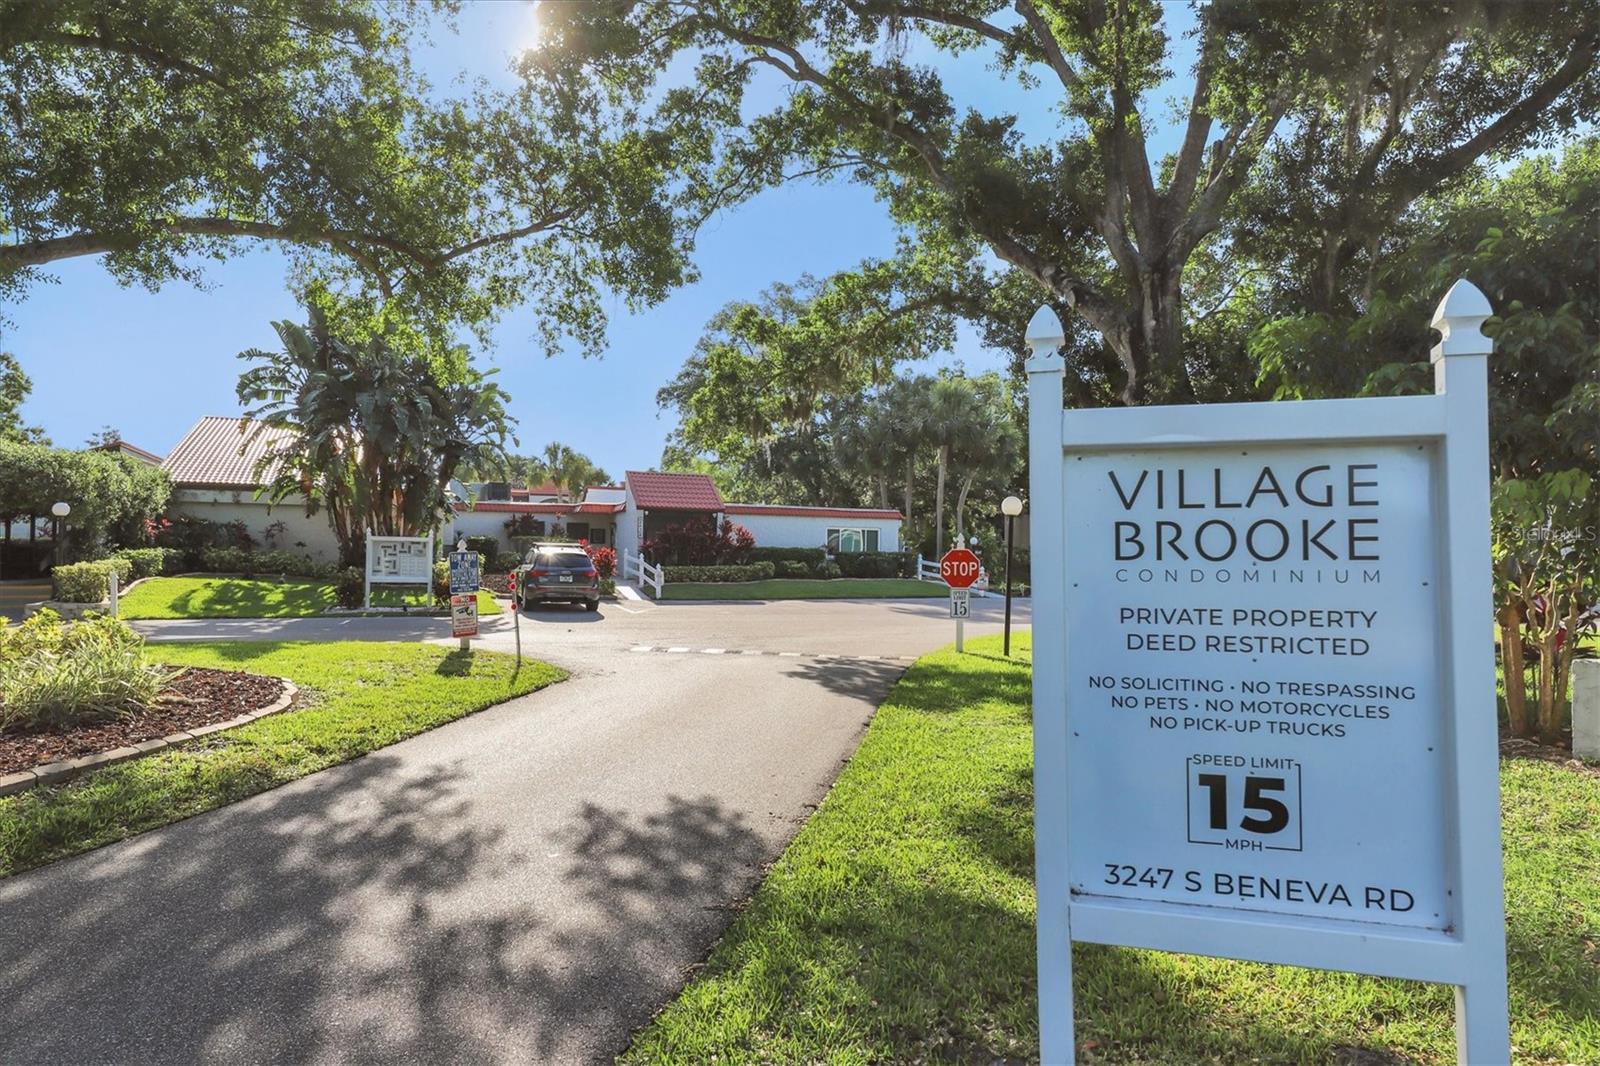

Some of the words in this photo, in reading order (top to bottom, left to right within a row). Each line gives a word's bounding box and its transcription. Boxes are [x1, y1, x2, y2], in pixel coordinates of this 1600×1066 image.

[1107, 464, 1379, 510] VILLAGE
[1114, 518, 1380, 562] BROOKE
[943, 561, 977, 576] STOP
[1115, 568, 1381, 584] CONDOMINIUM
[953, 601, 967, 616] 15
[1120, 607, 1223, 626] PRIVATE
[1233, 609, 1378, 629] PROPERTY
[1127, 633, 1196, 651] DEED
[1205, 635, 1369, 656] RESTRICTED
[1088, 675, 1116, 690] NO
[1120, 676, 1224, 694] SOLICITING
[1241, 681, 1271, 695] NO
[1276, 681, 1416, 701] TRESPASSING
[1111, 696, 1138, 710] NO
[1144, 697, 1189, 711] PETS
[1205, 699, 1234, 713] NO
[1240, 700, 1391, 720] MOTORCYCLES
[1150, 716, 1177, 730] NO
[1183, 717, 1261, 733] PICK-UP
[1267, 721, 1346, 738] TRUCKS
[1192, 754, 1246, 768] SPEED
[1250, 756, 1295, 771] LIMIT
[1198, 773, 1290, 835] 15
[1225, 838, 1263, 852] MPH
[1104, 863, 1174, 890] 3247
[1185, 871, 1202, 892] S
[1214, 873, 1352, 907] BENEVA
[1365, 887, 1415, 913] RD
